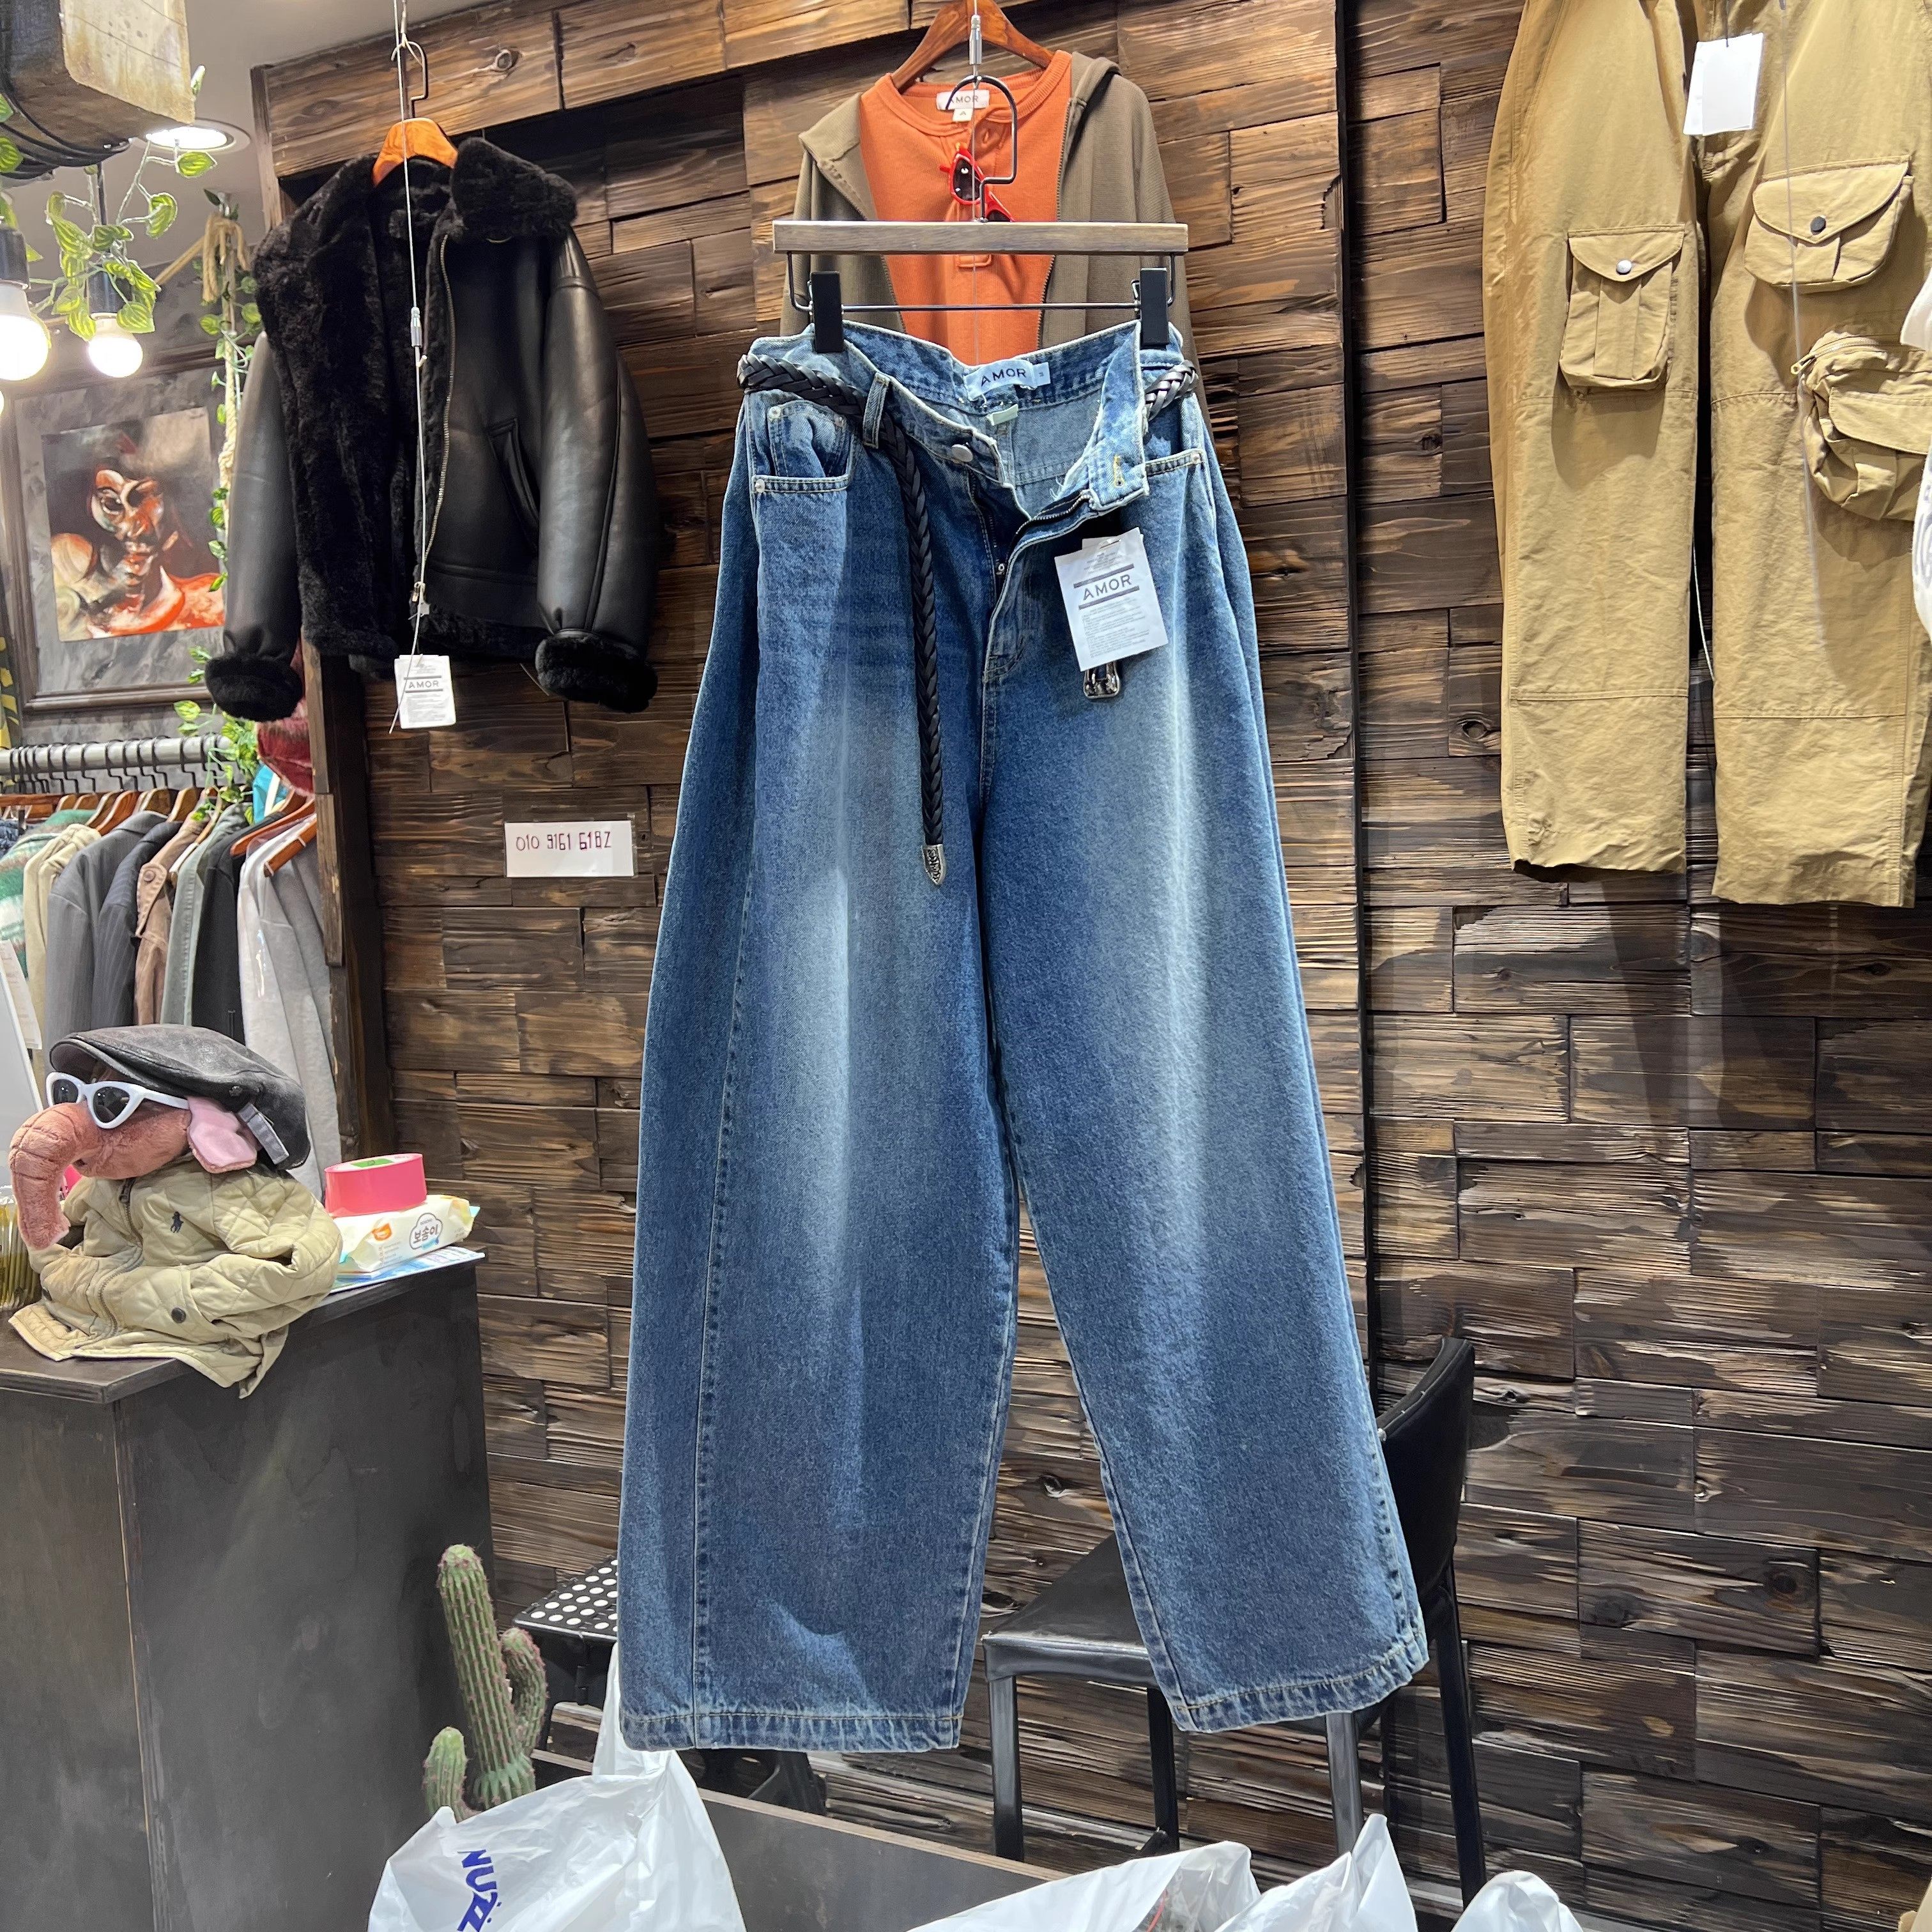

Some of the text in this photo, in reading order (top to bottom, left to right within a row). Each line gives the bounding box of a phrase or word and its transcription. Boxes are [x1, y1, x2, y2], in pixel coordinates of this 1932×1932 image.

[980, 368, 1027, 387] AMOR
[1083, 574, 1132, 601] AMOR
[408, 680, 440, 689] AMOR
[516, 834, 540, 851] 010
[413, 1223, 439, 1244] 보솜이
